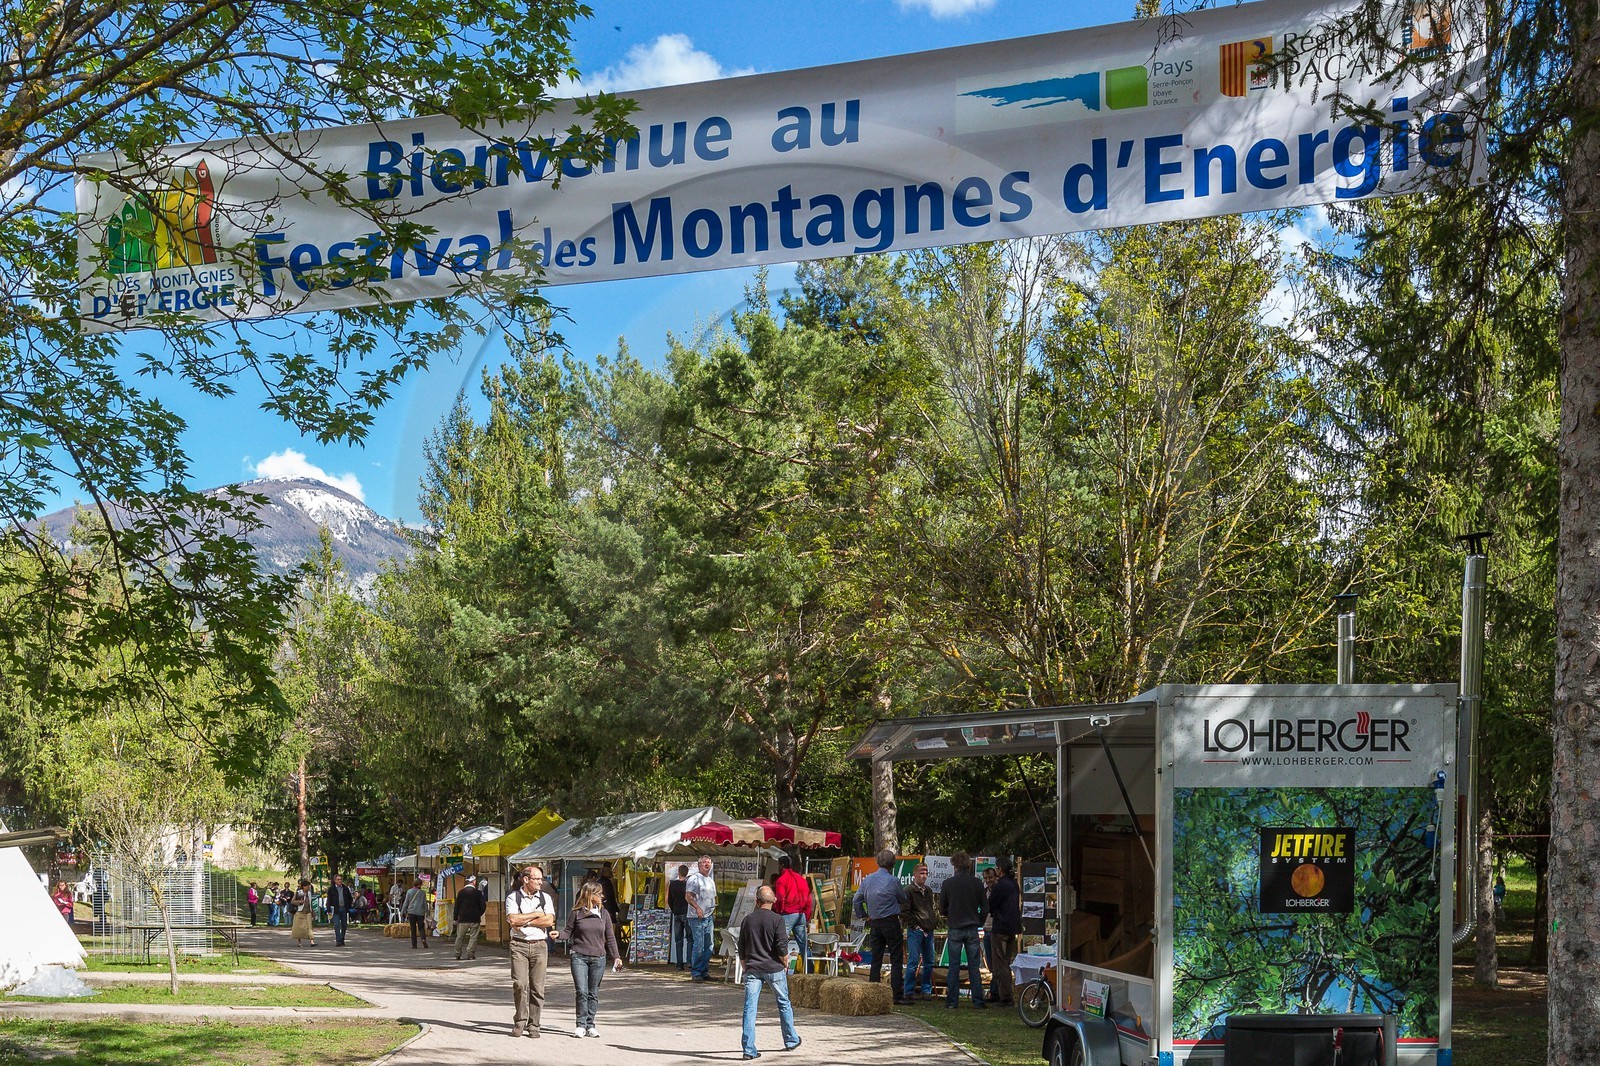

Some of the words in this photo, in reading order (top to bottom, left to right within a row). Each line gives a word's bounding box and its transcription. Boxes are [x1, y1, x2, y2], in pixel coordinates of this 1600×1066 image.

[1153, 60, 1193, 78] Pays
[1283, 51, 1373, 86] PACA
[1152, 79, 1194, 88] Serre-Ponçon
[1152, 90, 1172, 98] Ubaye
[1152, 98, 1179, 106] Durance
[366, 116, 733, 201] Bienvenue
[770, 98, 861, 153] au
[254, 209, 513, 296] Festival
[530, 227, 596, 268] des
[611, 170, 1034, 265] Montagnes
[116, 276, 141, 293] DES
[149, 267, 235, 289] MONTAGNES
[1203, 718, 1412, 752] LOHBERGER
[1241, 756, 1375, 766] WWW.LOHBERGER.COM
[1270, 834, 1347, 857] JETFIRE
[1285, 898, 1330, 907] LOHBERGER
